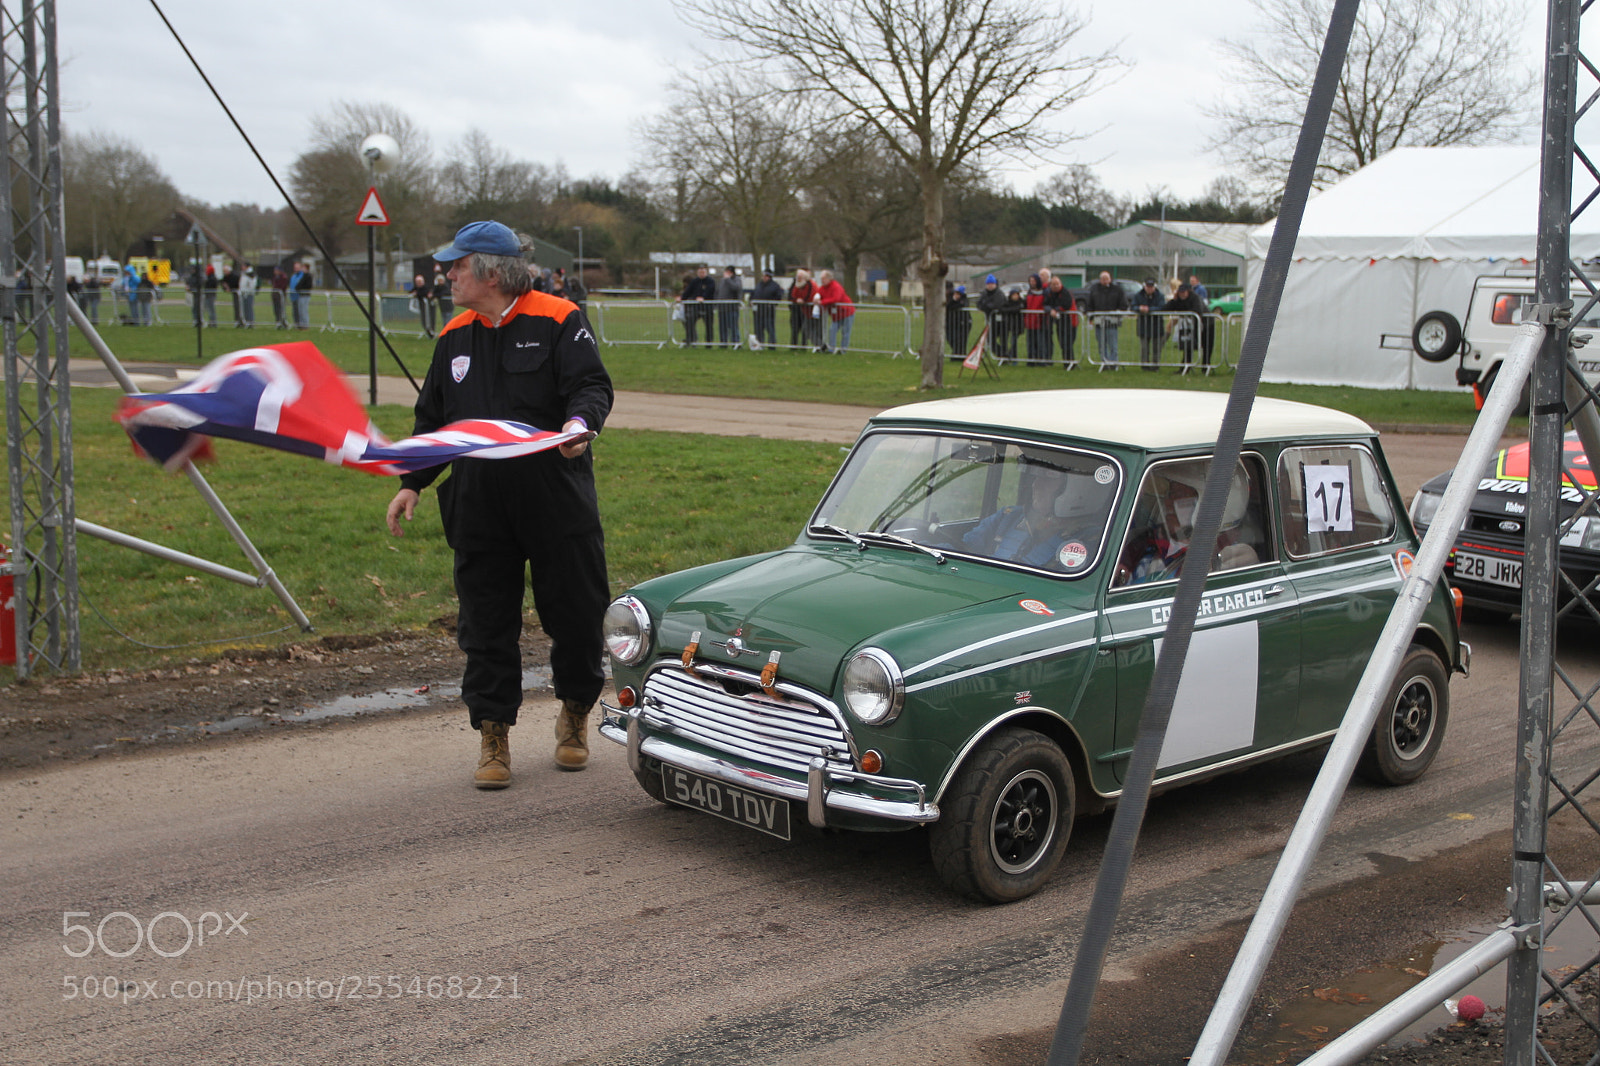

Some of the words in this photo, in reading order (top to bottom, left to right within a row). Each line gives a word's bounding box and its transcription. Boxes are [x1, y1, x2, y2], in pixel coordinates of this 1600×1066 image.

[1076, 248, 1093, 257] THE
[1095, 248, 1130, 257] KENNEL
[1314, 481, 1344, 522] 17
[1454, 555, 1485, 577] E28
[1490, 562, 1522, 585] JWK
[674, 772, 722, 812] 540
[726, 788, 776, 830] TDV
